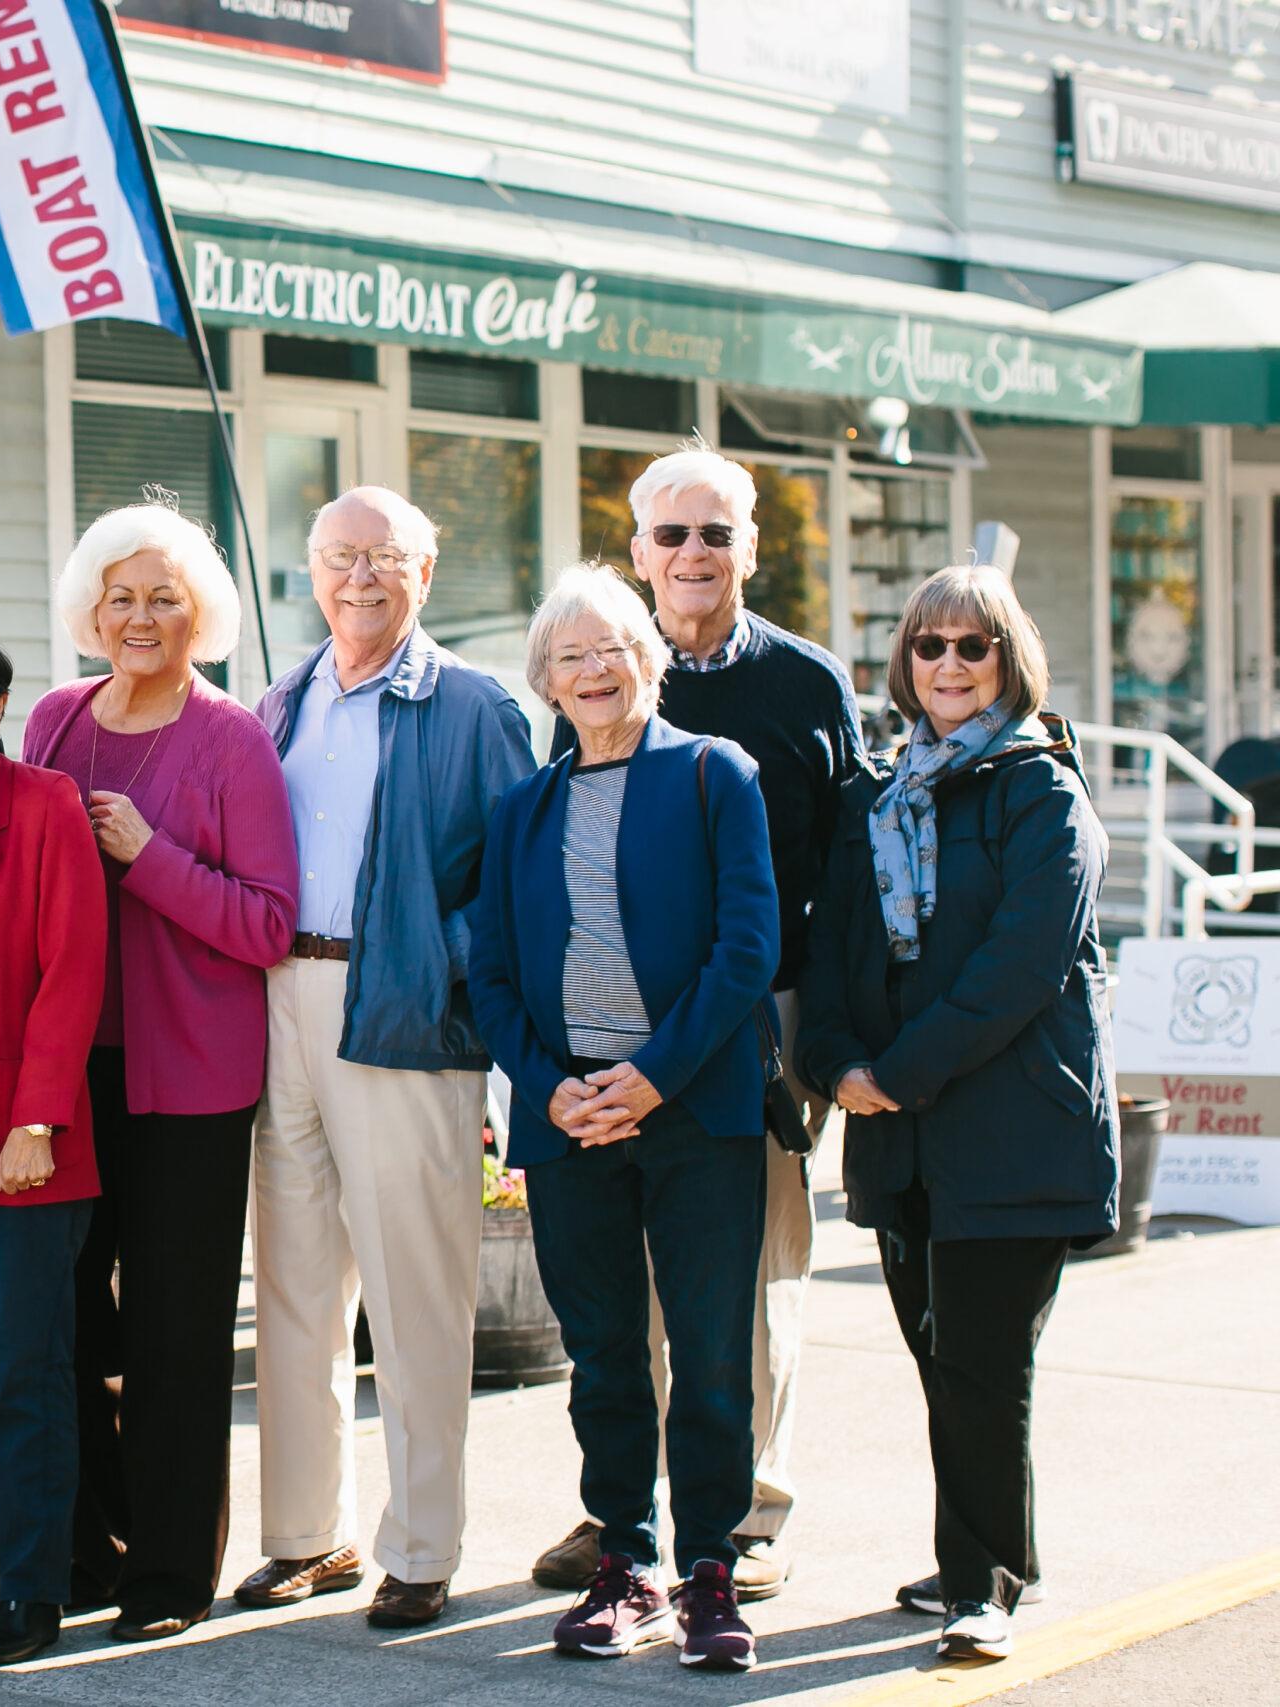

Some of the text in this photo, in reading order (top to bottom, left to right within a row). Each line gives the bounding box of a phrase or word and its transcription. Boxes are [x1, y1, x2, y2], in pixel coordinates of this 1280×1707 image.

[1121, 115, 1218, 172] PACIFIC
[21, 155, 123, 317] BOAT
[194, 240, 374, 328] ELECTRIC
[375, 263, 471, 337] BOAT
[473, 270, 600, 350] Café
[597, 313, 620, 352] &
[867, 311, 1059, 404] Allure Salon
[1161, 1074, 1248, 1105] Venue
[1196, 1106, 1264, 1136] Rent
